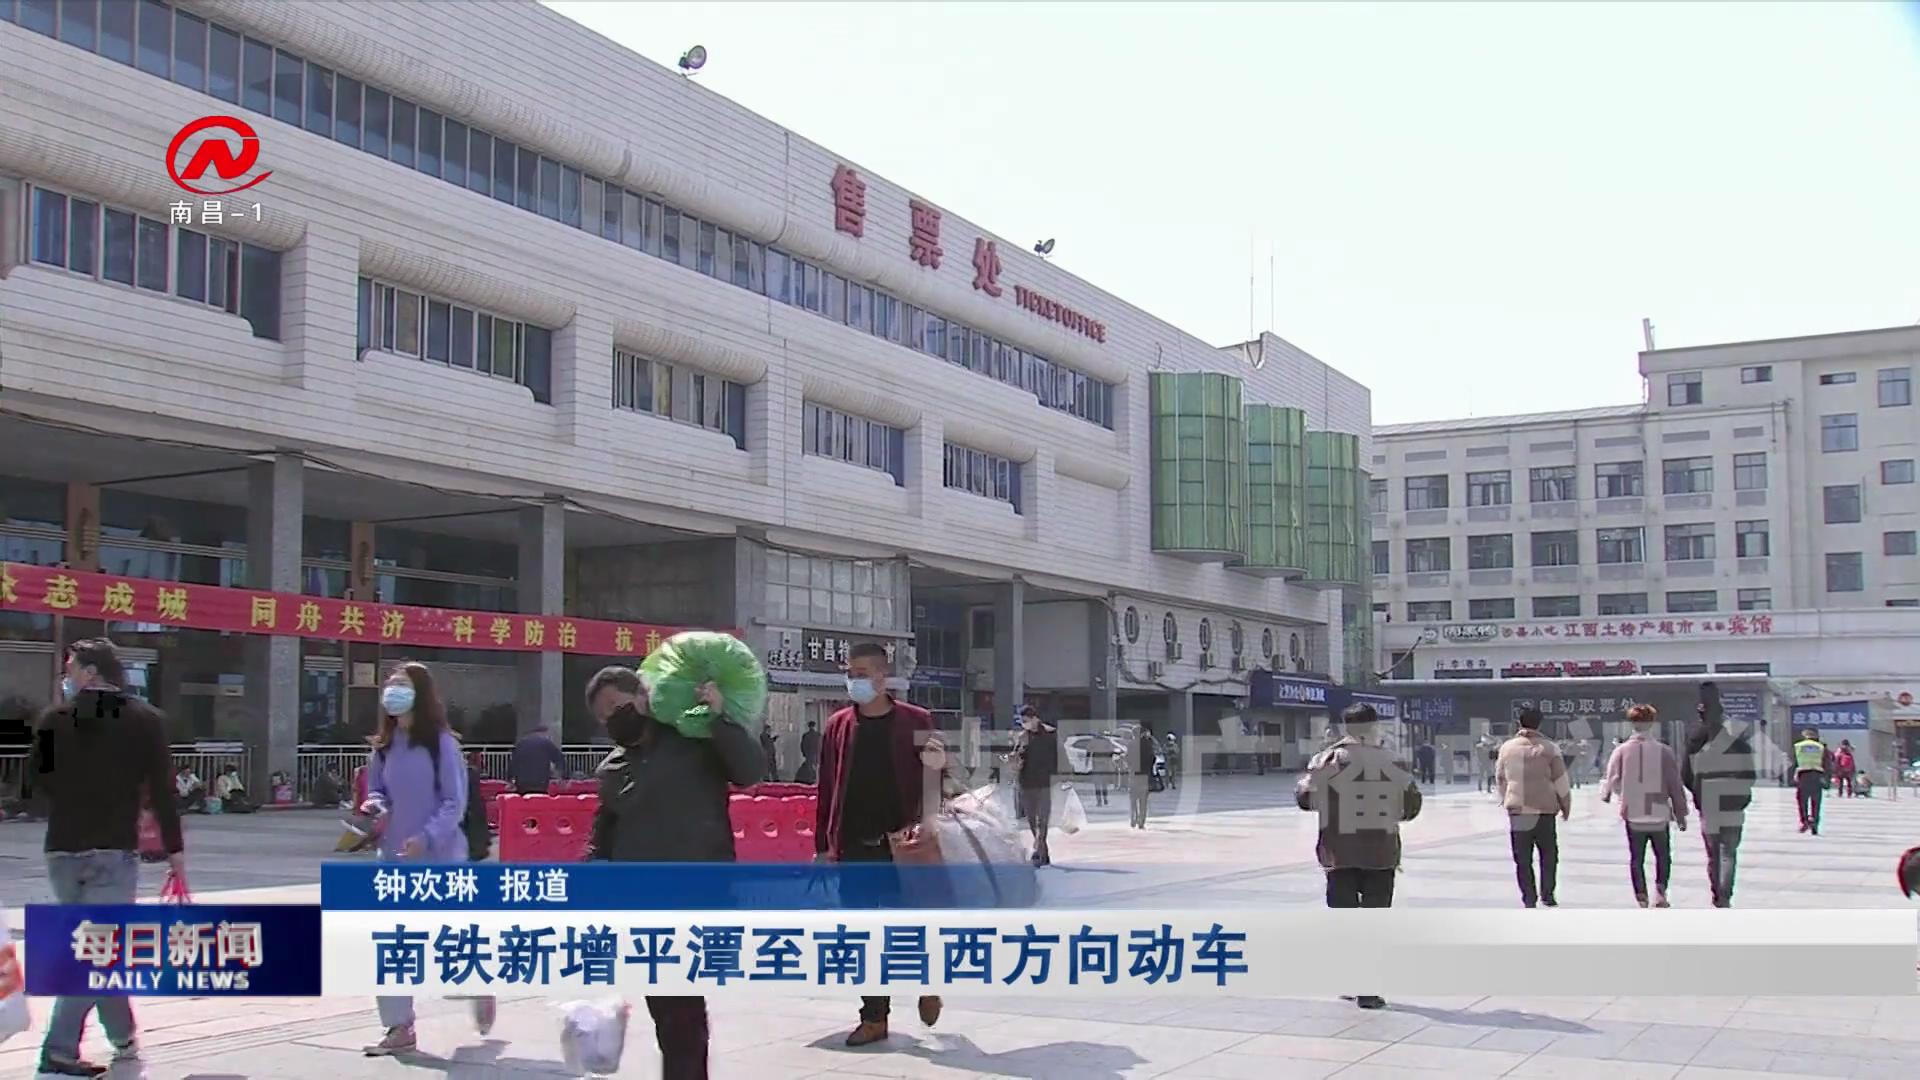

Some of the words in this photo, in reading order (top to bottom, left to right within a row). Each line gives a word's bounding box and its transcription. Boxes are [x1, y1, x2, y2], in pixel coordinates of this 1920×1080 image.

[830, 164, 1003, 297] 售票处
[251, 596, 405, 639] 同舟共济
[453, 616, 576, 648] 科学防治
[1564, 619, 1695, 637] 江西土特产超市
[1728, 615, 1773, 635] 宾馆
[1540, 698, 1638, 713] 自动取票处
[1793, 711, 1866, 725] 应急取票处
